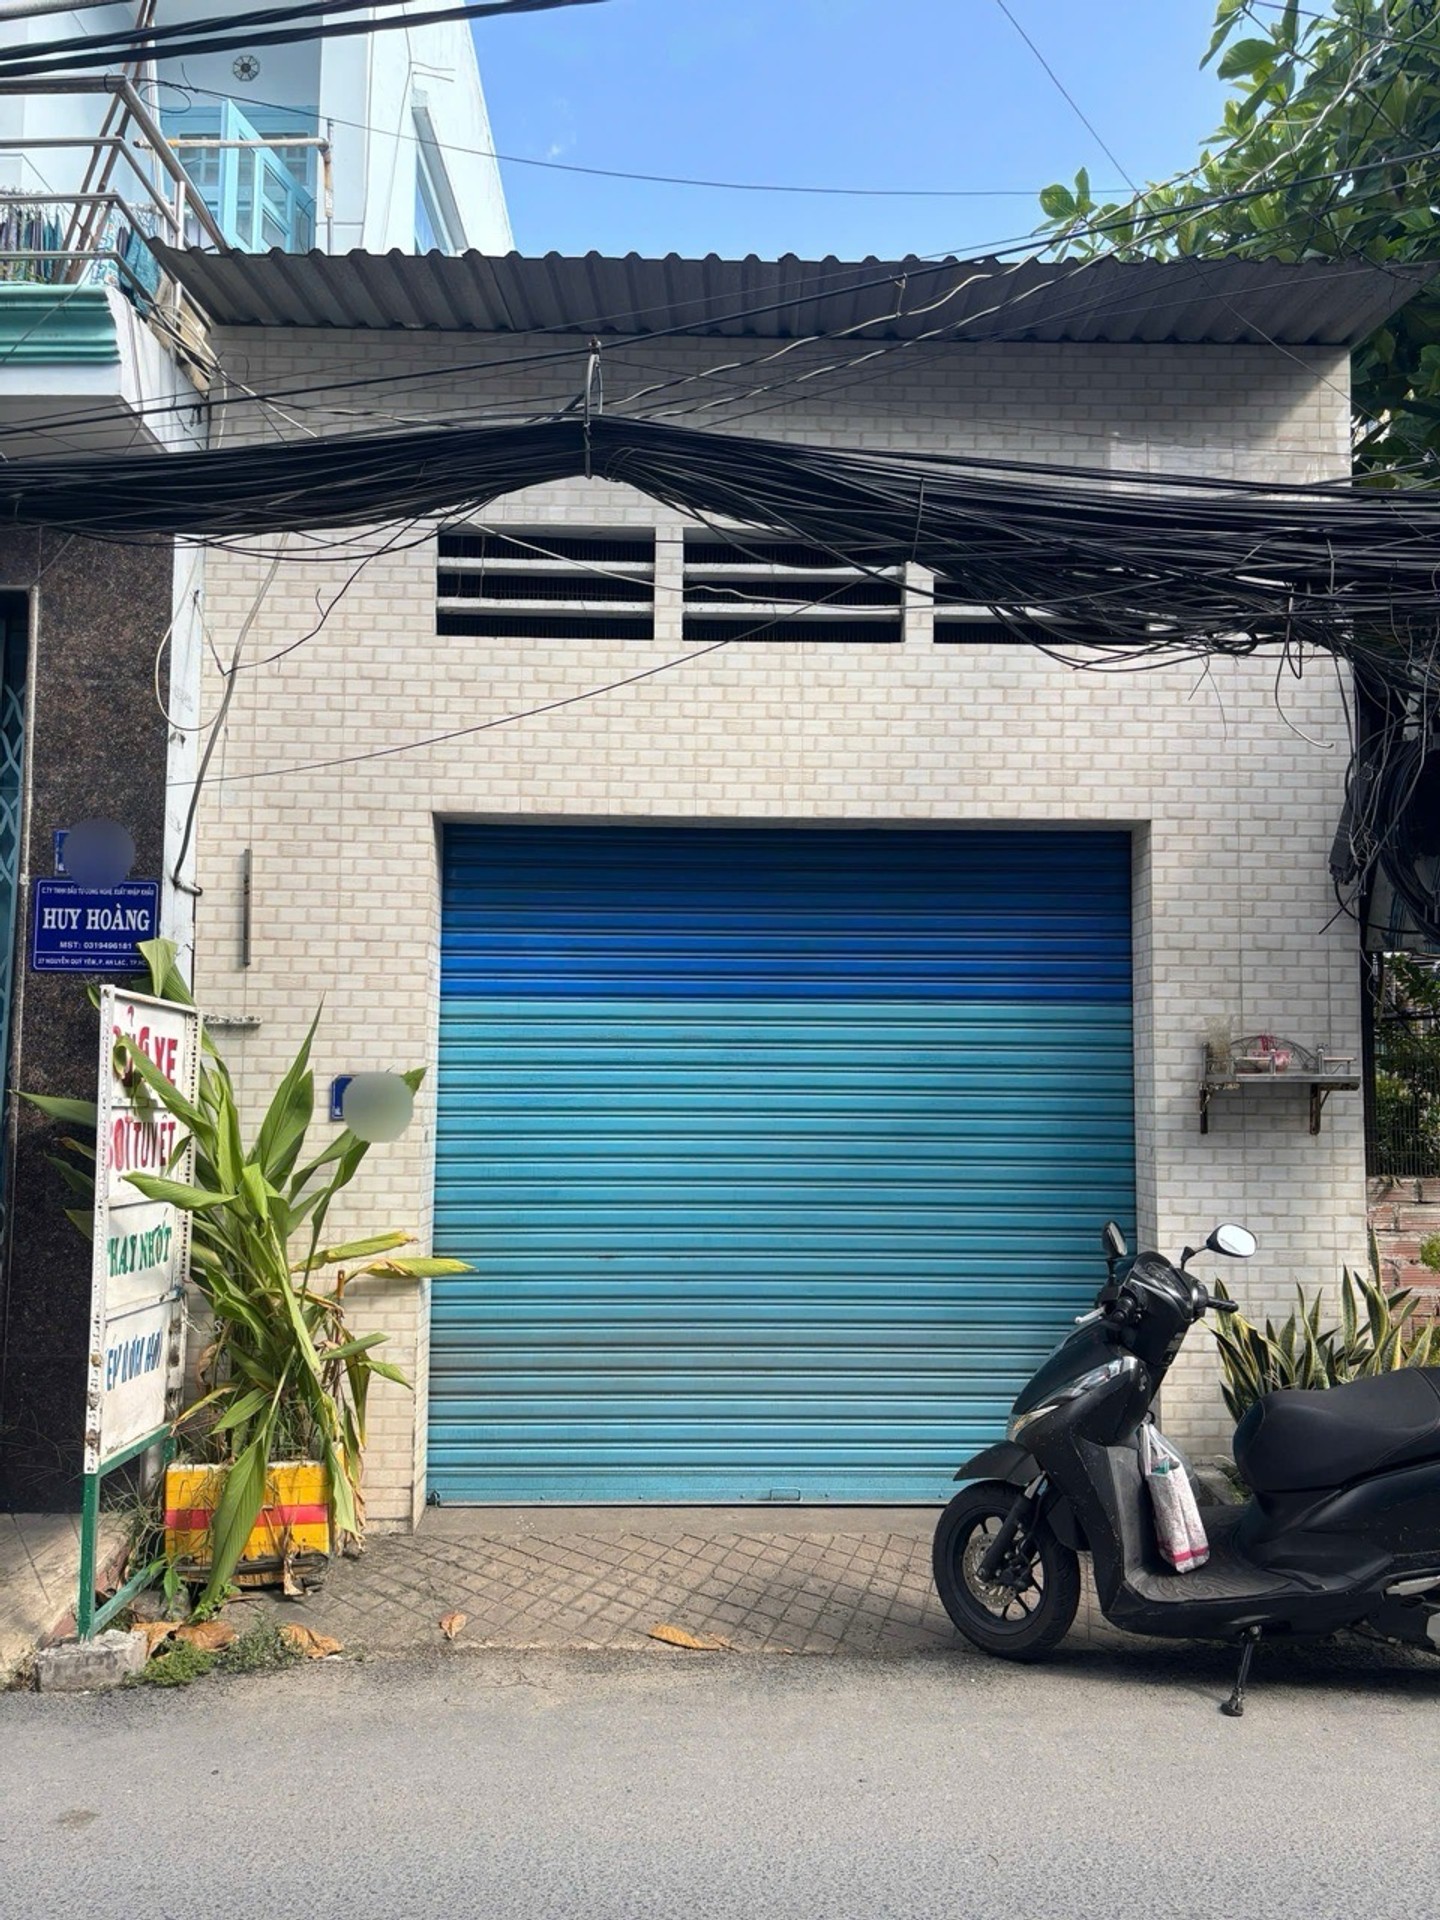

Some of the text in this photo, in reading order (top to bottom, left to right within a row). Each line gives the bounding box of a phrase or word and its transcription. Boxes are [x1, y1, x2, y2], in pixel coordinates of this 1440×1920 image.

[42, 903, 150, 932] HUY HOÀNG
[59, 940, 81, 950] MST:
[106, 1232, 137, 1277] HAY
